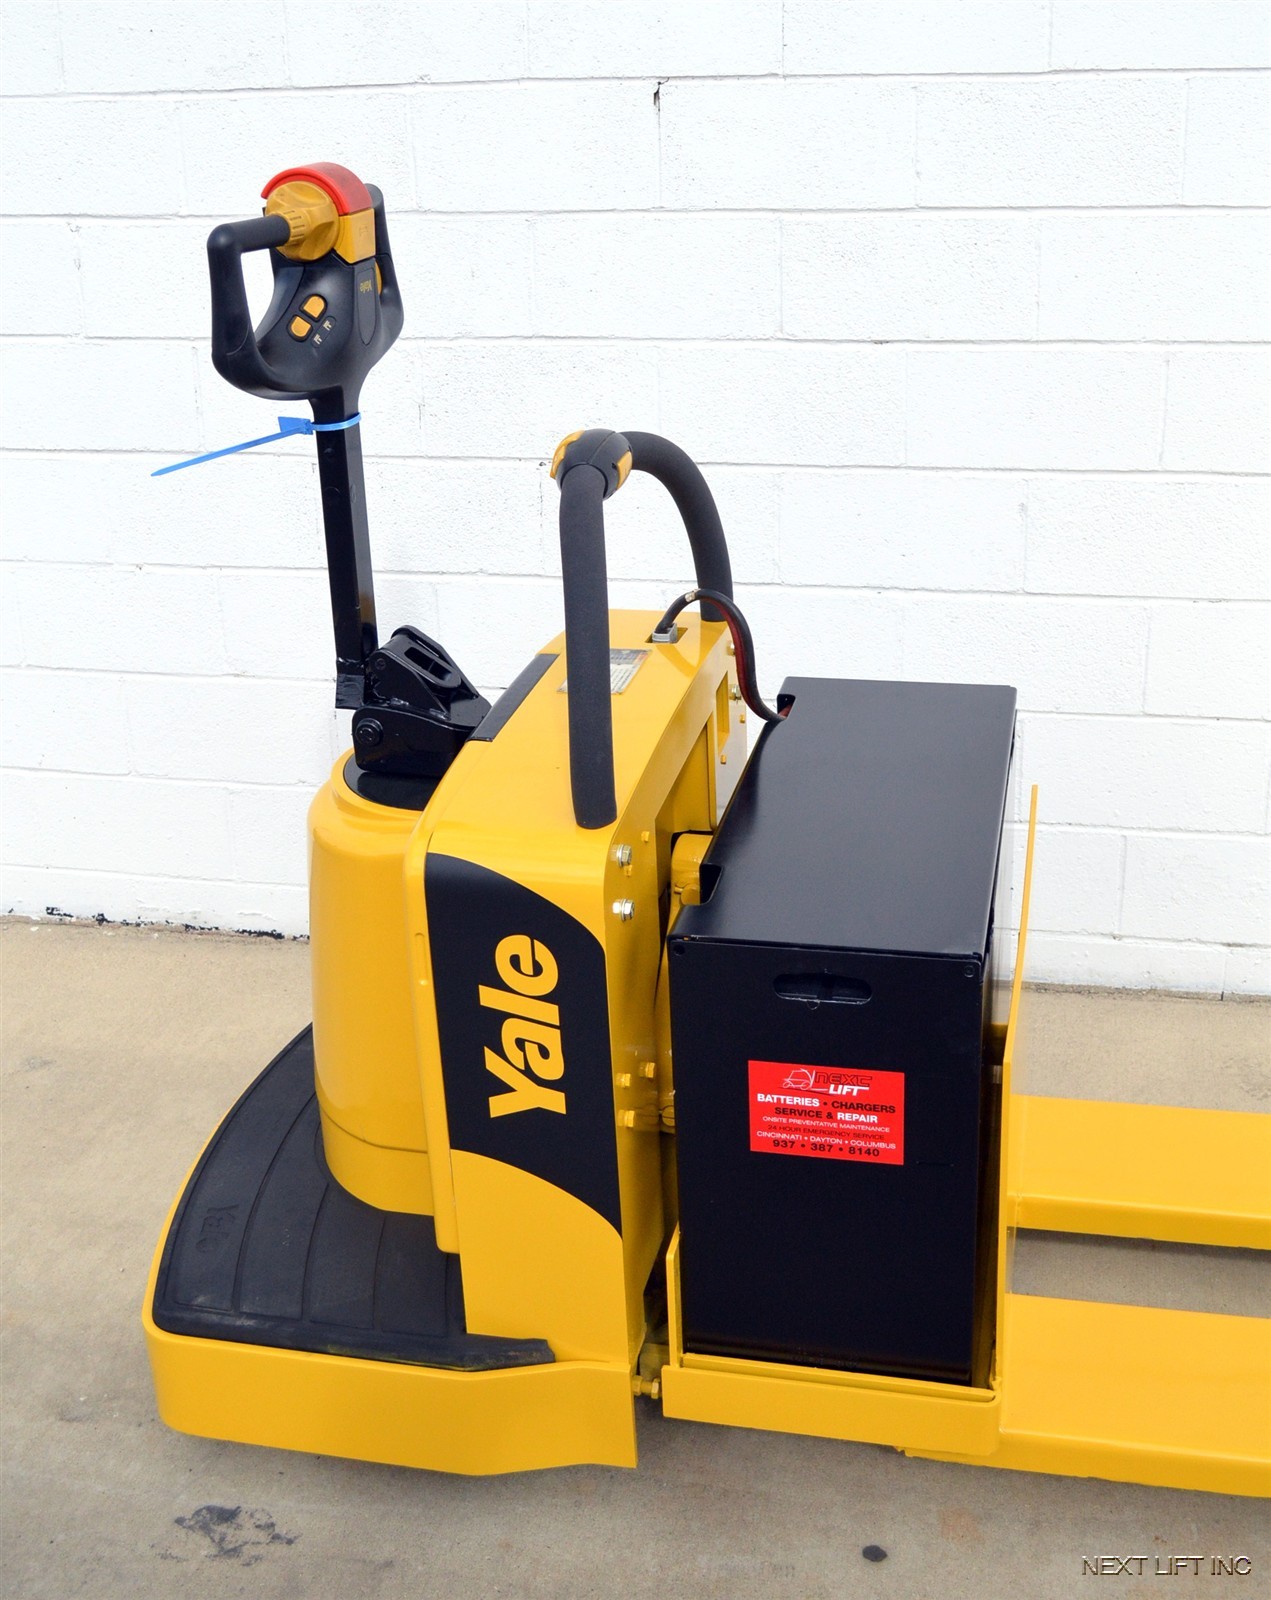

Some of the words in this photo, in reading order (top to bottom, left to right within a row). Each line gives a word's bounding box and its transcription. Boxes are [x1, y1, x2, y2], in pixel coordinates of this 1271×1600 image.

[478, 933, 567, 1119] Yale
[828, 1084, 869, 1096] LIFT
[757, 1093, 820, 1107] BATTERIES
[831, 1100, 896, 1114] CHARGERS
[774, 1106, 823, 1119] SERVICE
[826, 1111, 834, 1120] &
[837, 1112, 878, 1123] REPAIR
[762, 1116, 787, 1124] ONSITE
[789, 1118, 838, 1129] PREVENTATIVE
[839, 1123, 890, 1133] MAINTENANCE
[756, 1130, 802, 1141] CINCINNATI
[809, 1136, 843, 1145] DAYTON
[850, 1140, 896, 1150] COLUMBUS
[803, 1128, 850, 1138] EMERGENCY
[852, 1132, 885, 1140] SERVICE
[772, 1139, 795, 1149] 937
[810, 1143, 833, 1153] 387
[848, 1147, 880, 1157] 8140
